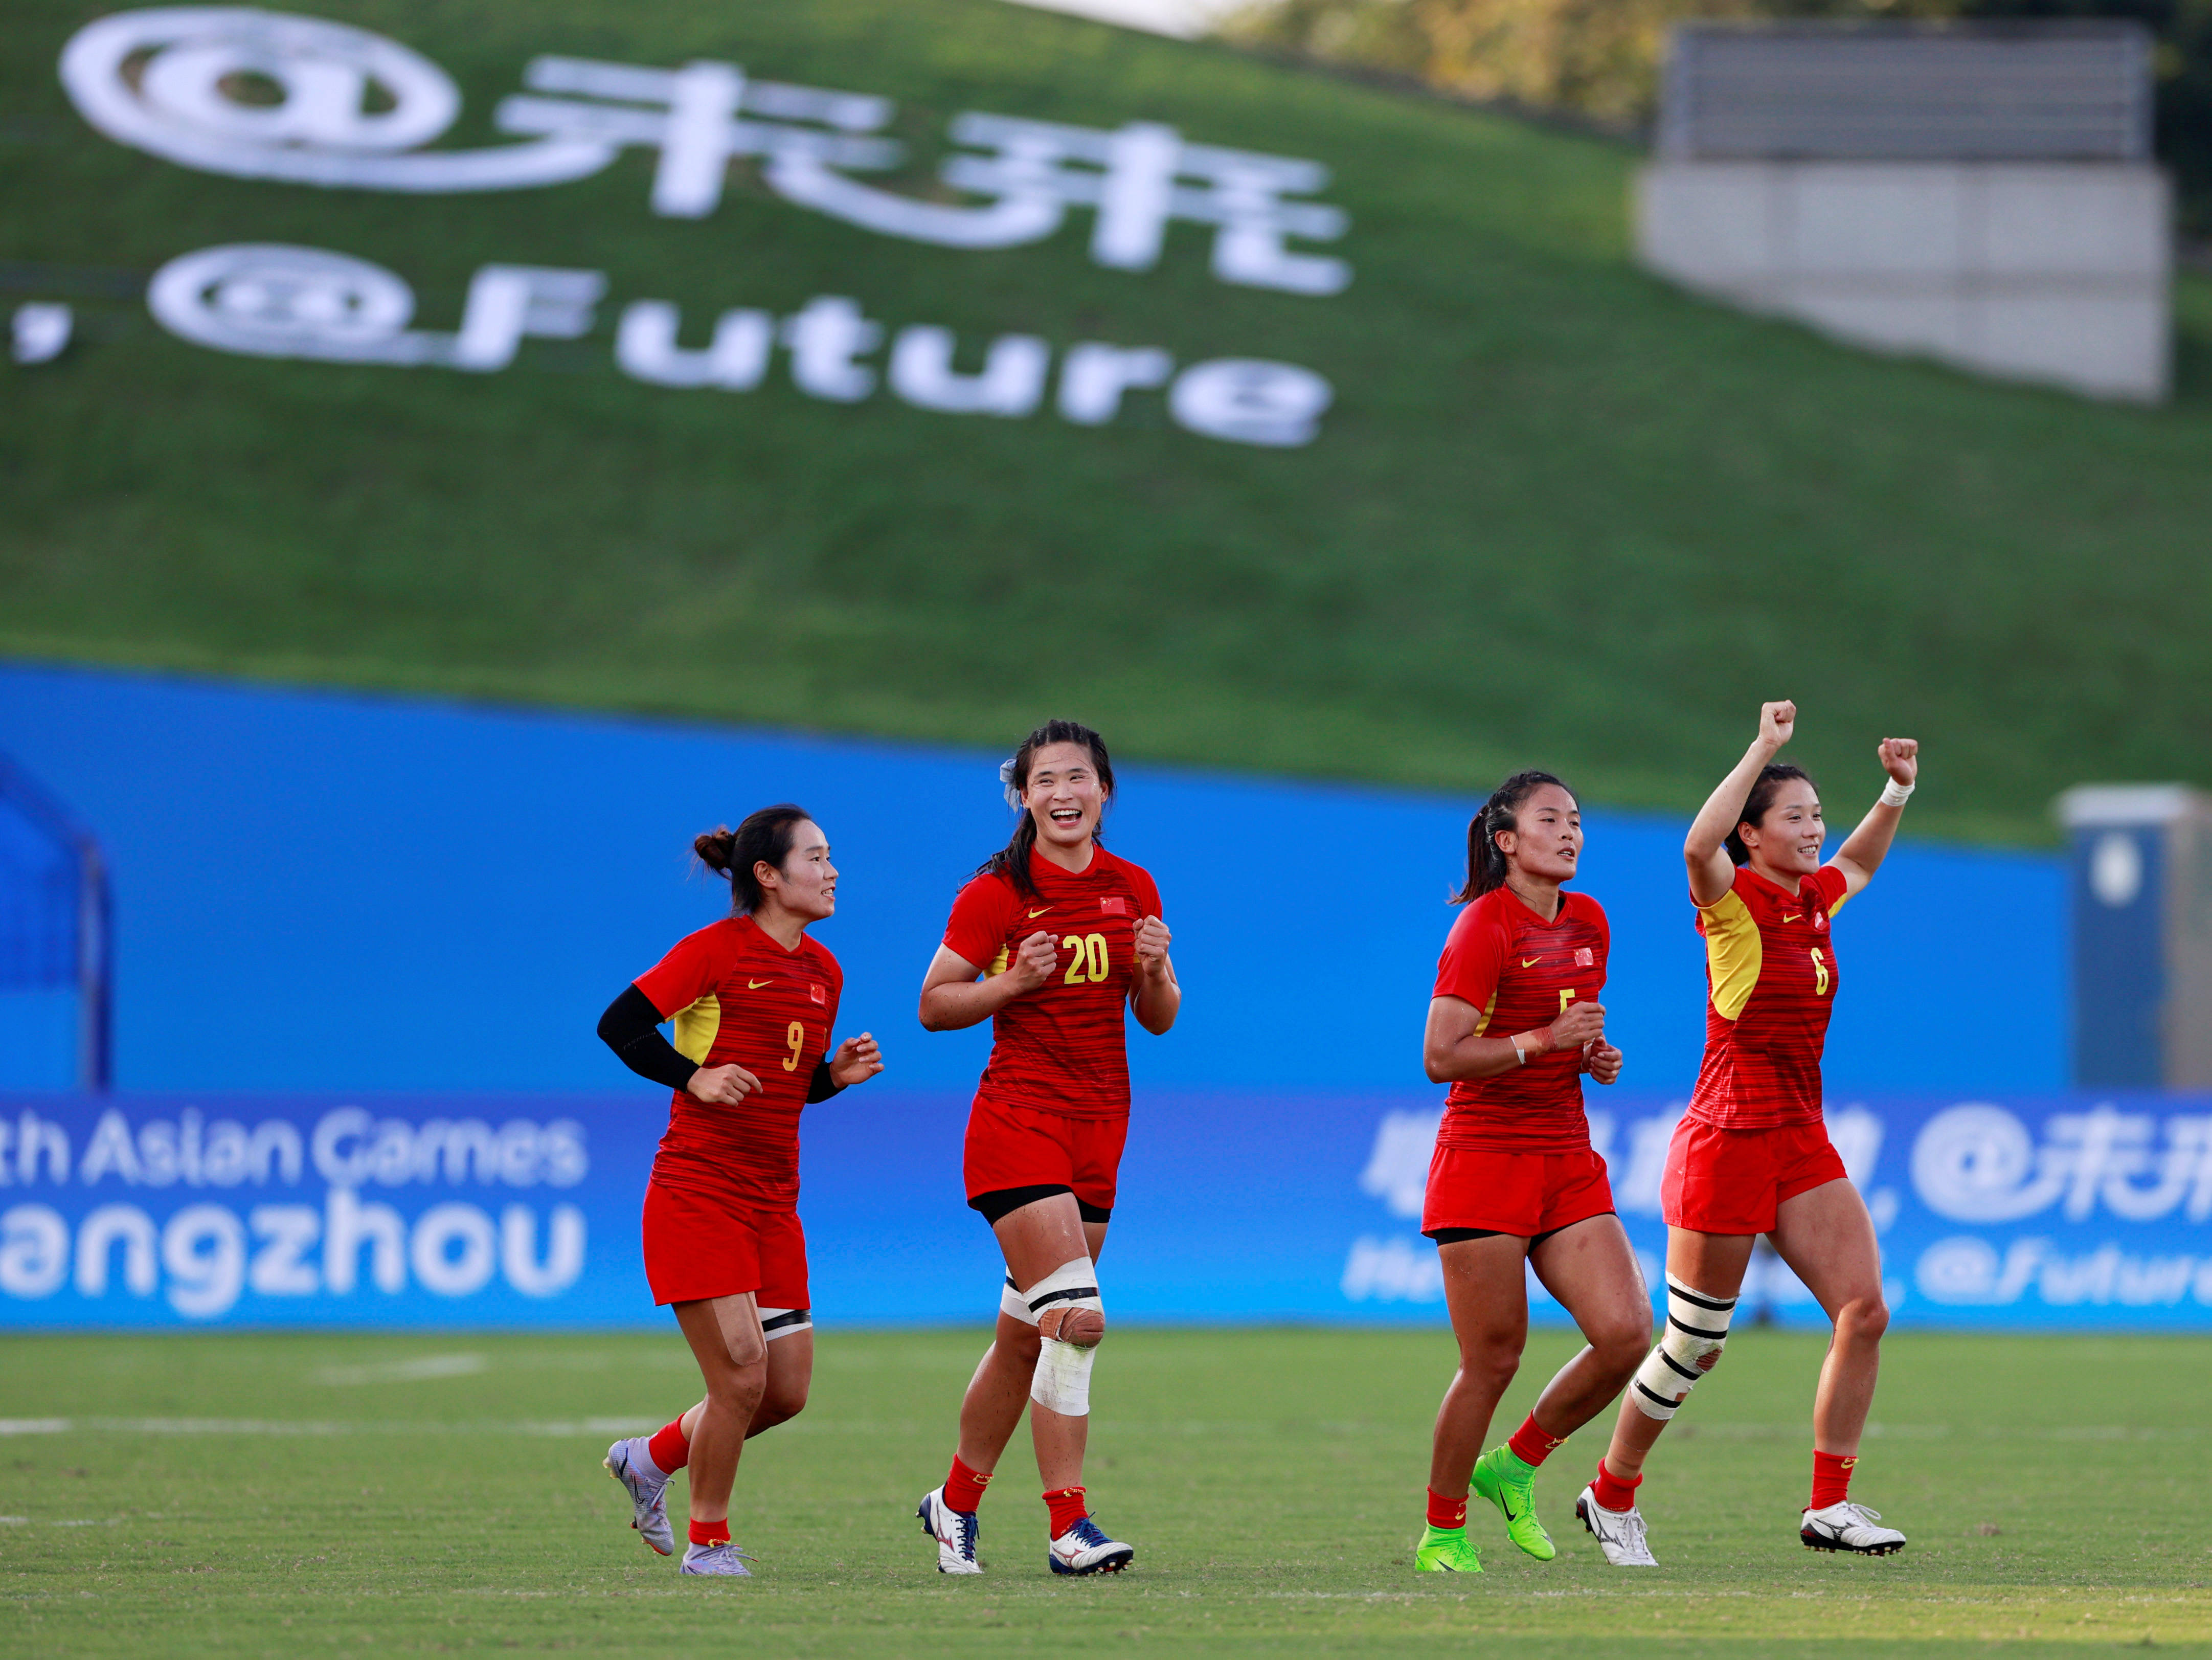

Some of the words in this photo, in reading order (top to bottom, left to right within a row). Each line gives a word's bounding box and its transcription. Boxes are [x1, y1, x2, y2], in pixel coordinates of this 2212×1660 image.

[146, 241, 1334, 448] @Future
[1063, 933, 1109, 984] 20
[1811, 948, 1829, 995] 6
[783, 1021, 804, 1071] 9
[81, 1106, 303, 1187] Asian
[311, 1105, 589, 1187] Games
[0, 1185, 586, 1318] angzhou
